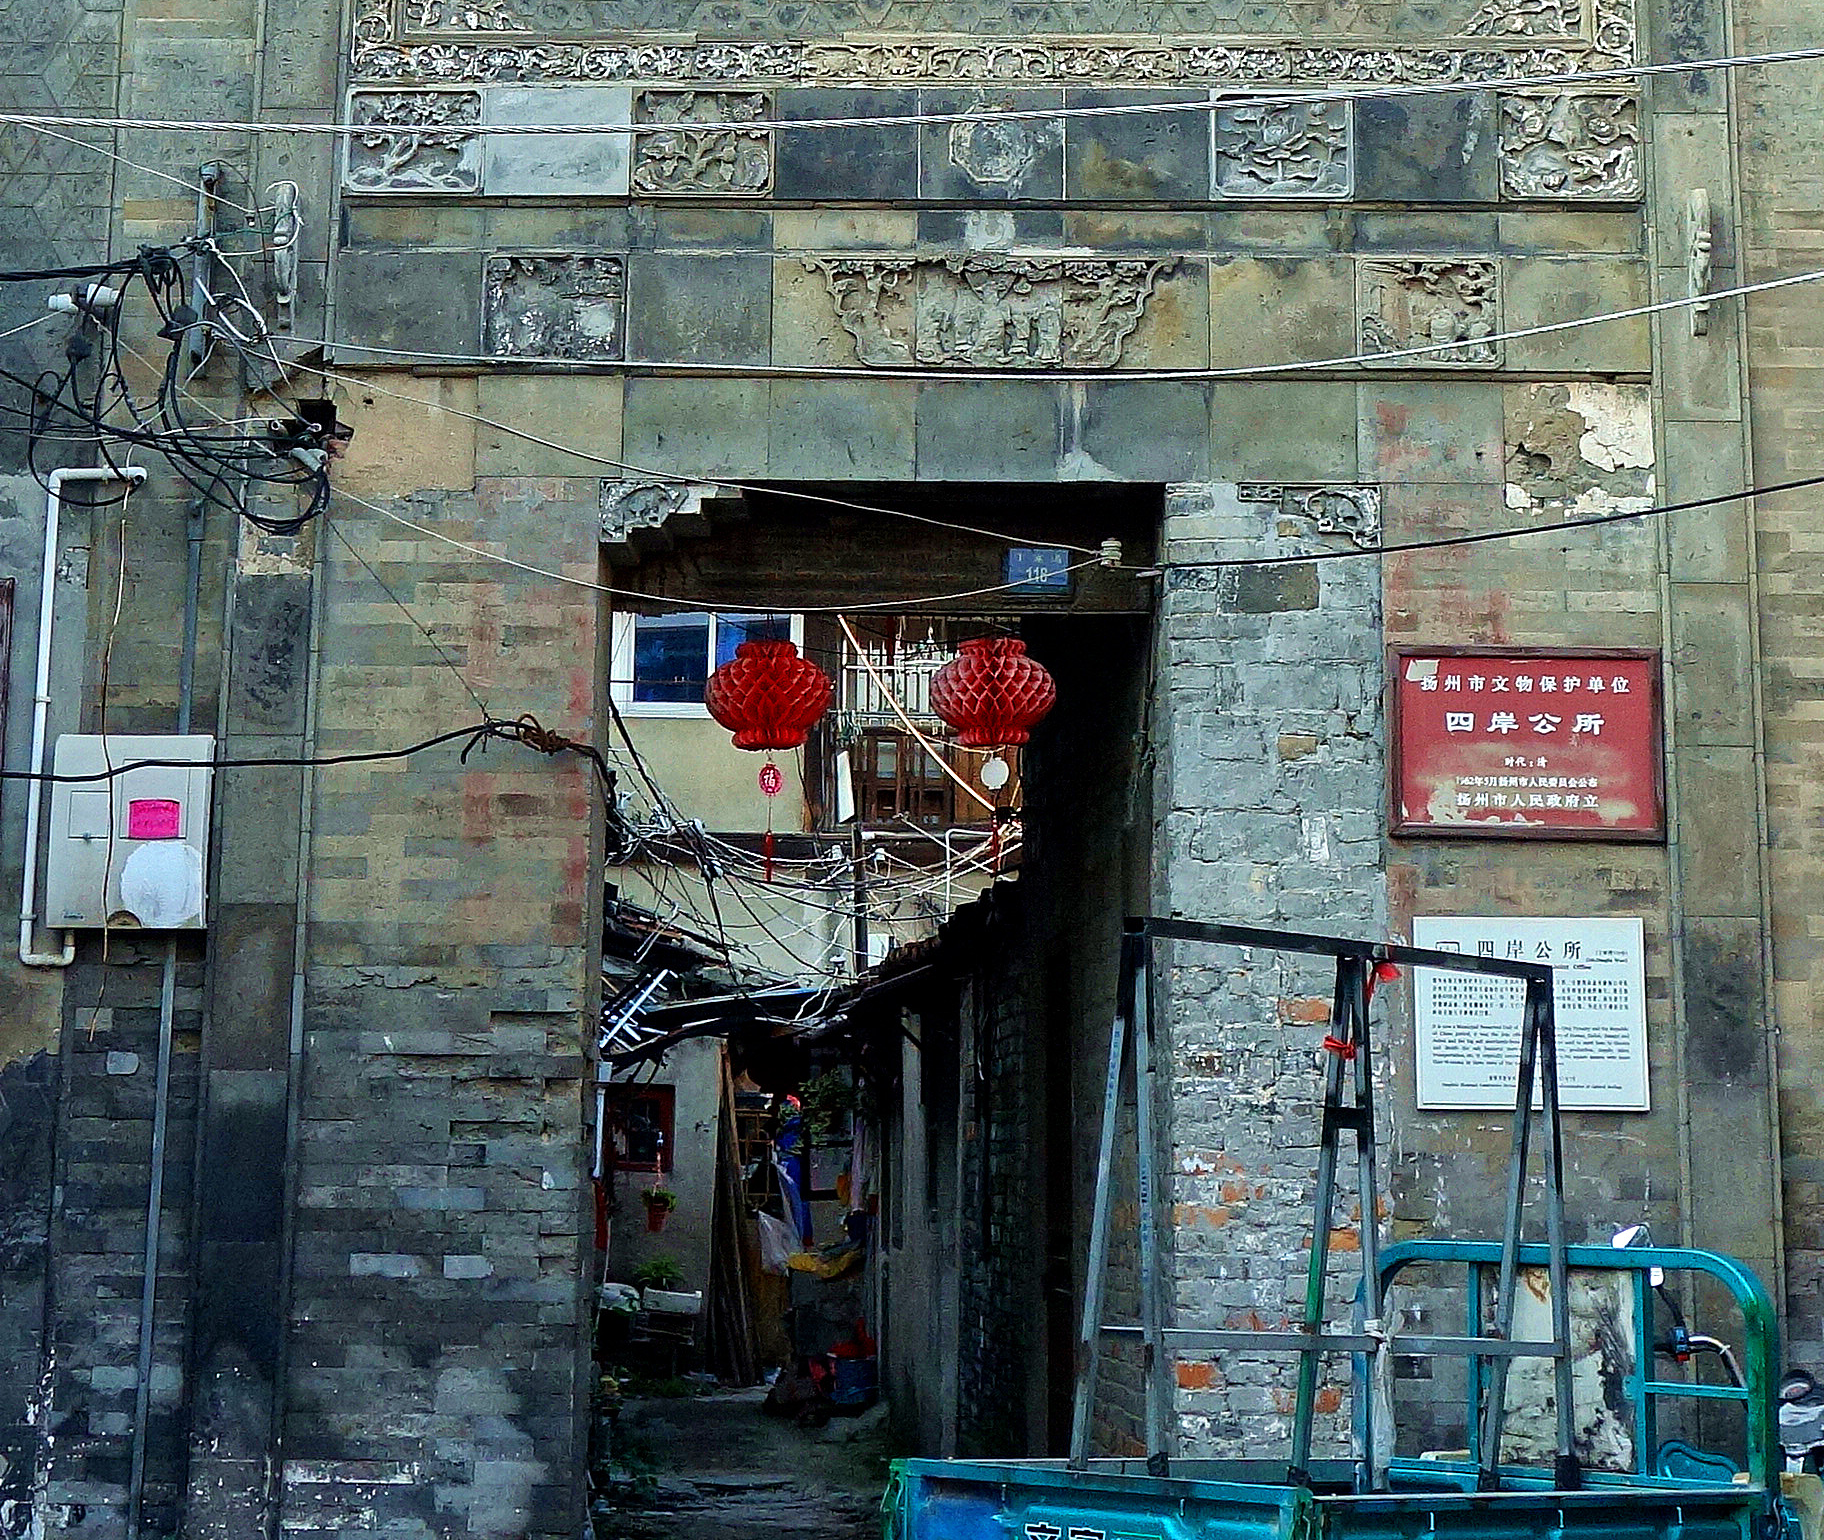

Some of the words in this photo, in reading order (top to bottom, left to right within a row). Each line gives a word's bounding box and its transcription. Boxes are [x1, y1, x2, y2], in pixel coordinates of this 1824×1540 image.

[1421, 675, 1630, 693] 扬州市文物保护单位
[1445, 712, 1605, 735] 四岸公所
[1456, 793, 1599, 808] 扬州市人民政府立
[1478, 939, 1582, 960] 四岸公所
